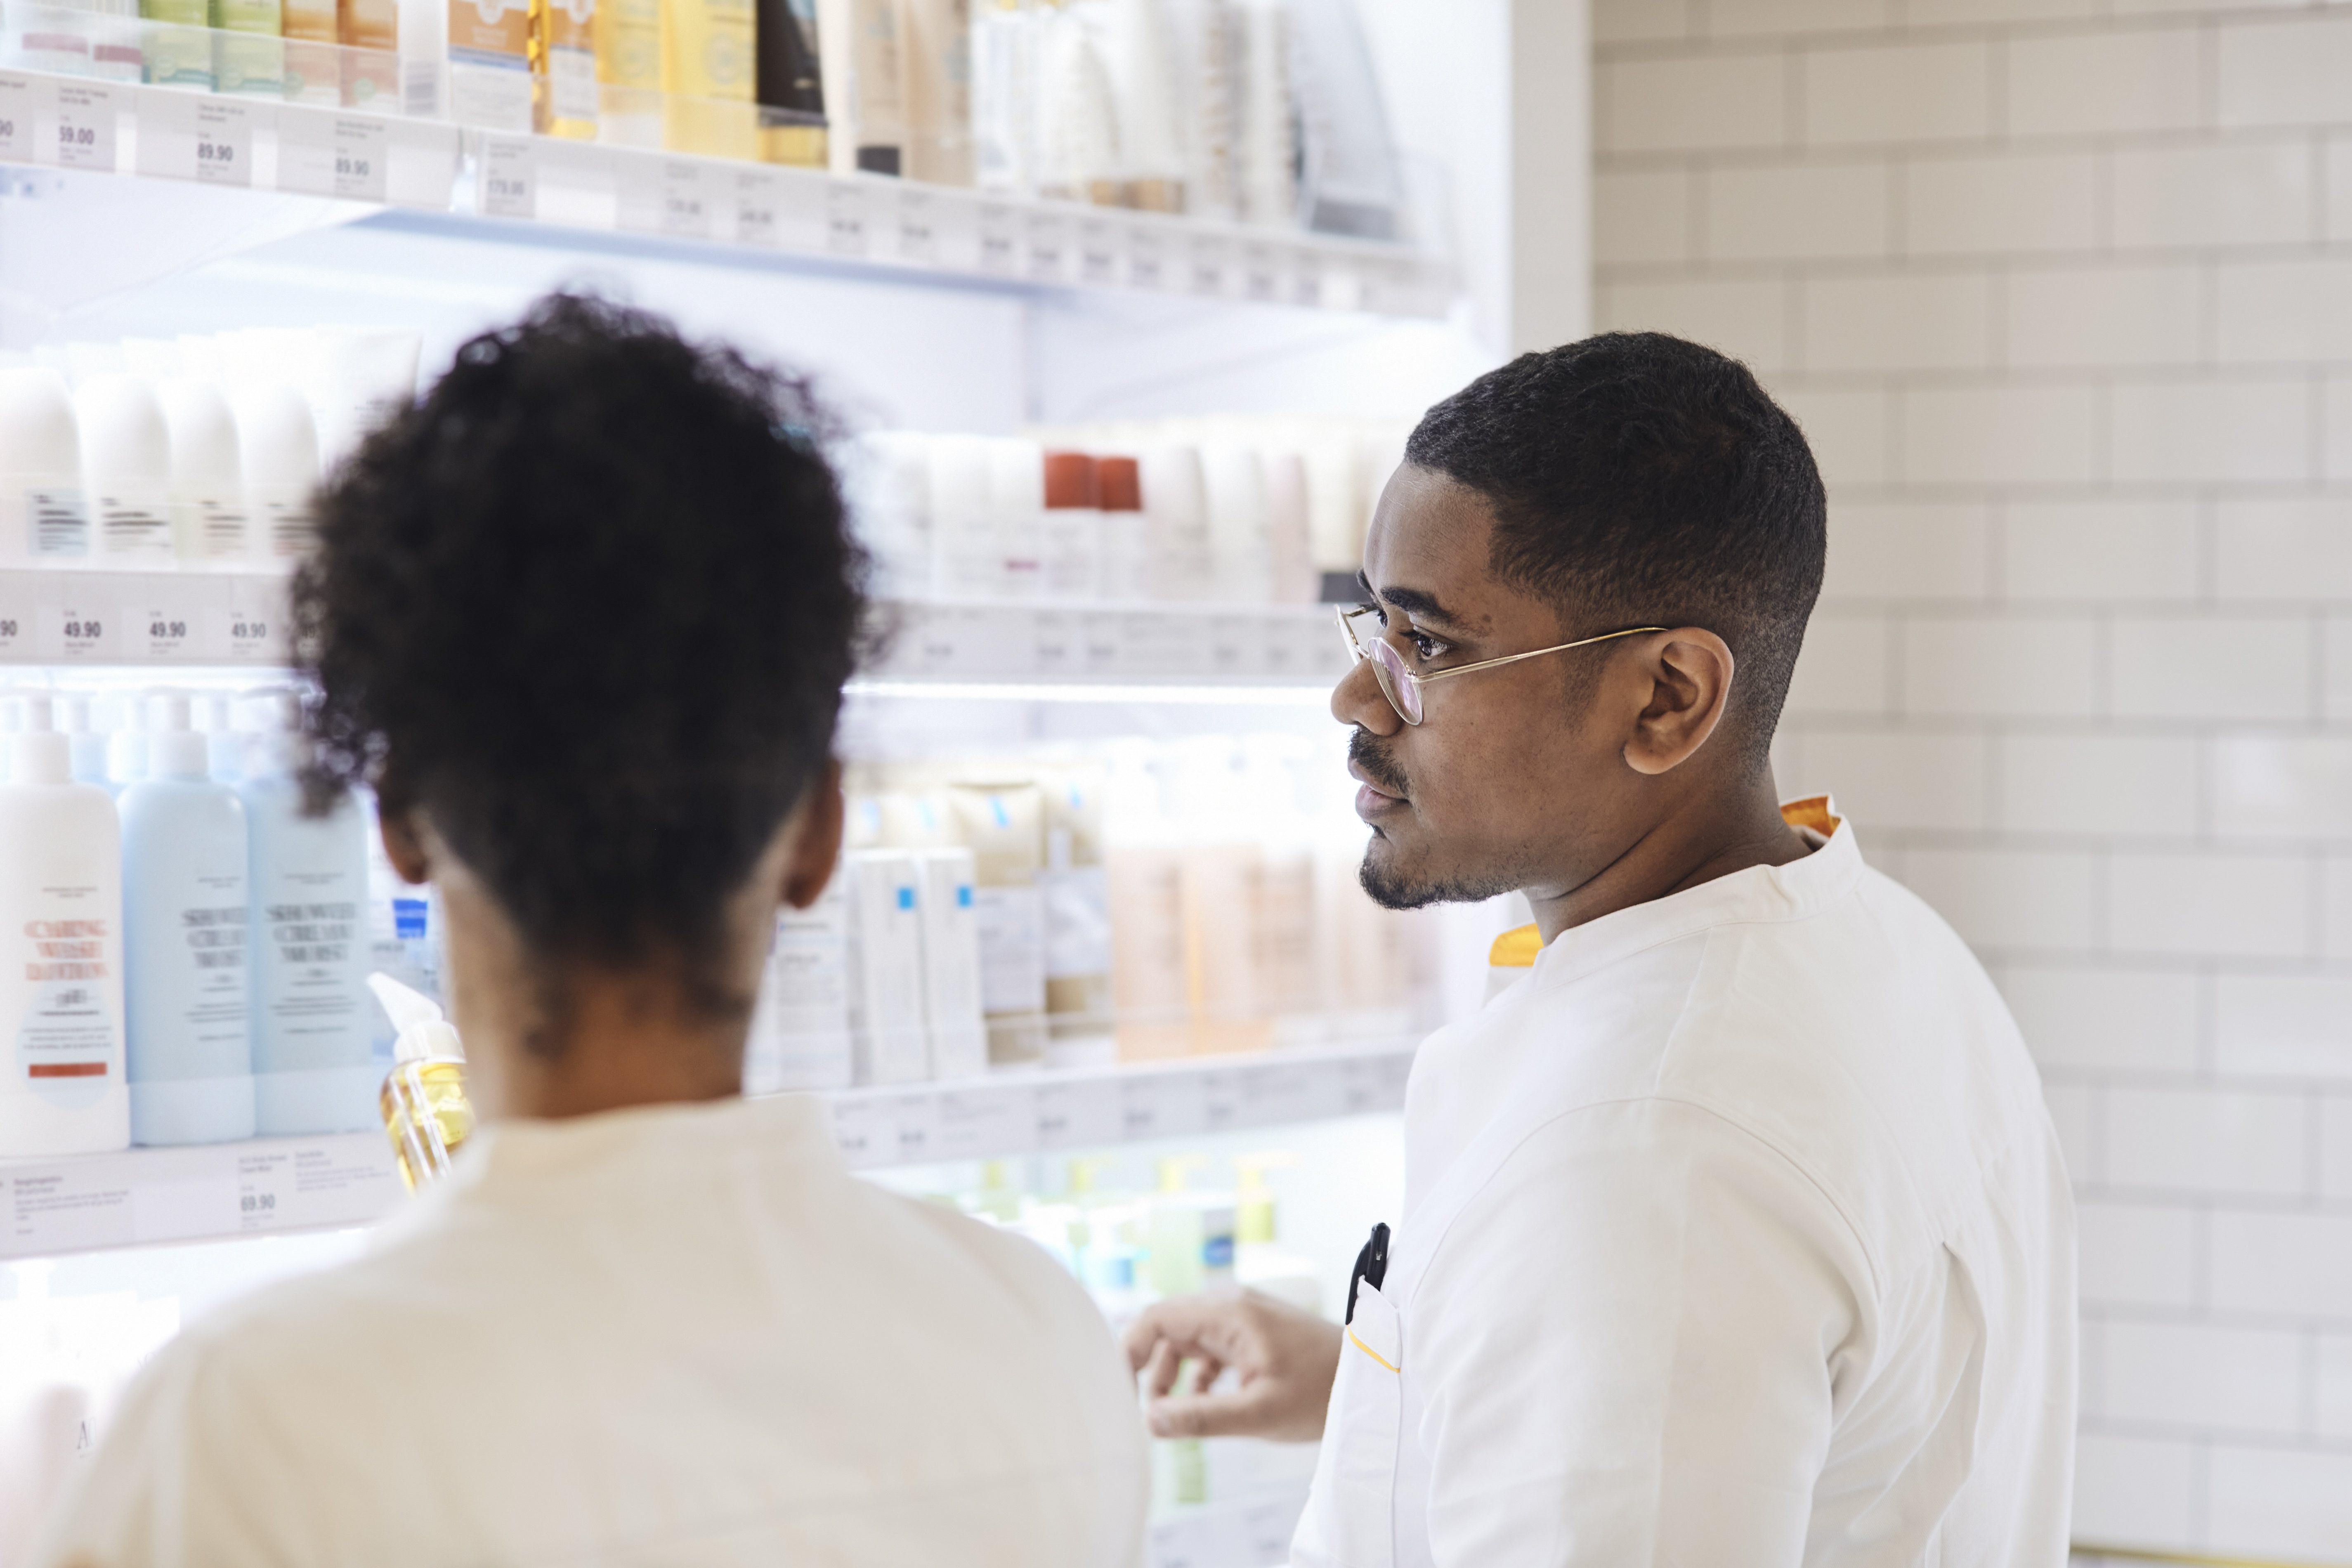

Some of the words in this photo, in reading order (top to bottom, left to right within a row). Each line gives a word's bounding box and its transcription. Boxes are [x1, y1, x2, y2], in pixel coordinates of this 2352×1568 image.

[59, 125, 94, 145] 59.00
[198, 142, 233, 162] 89.90
[336, 157, 370, 177] 89.90
[64, 621, 102, 638] 49.90
[149, 621, 186, 638] 49.90
[231, 622, 267, 638] 49.90
[241, 1193, 275, 1211] 69.90
